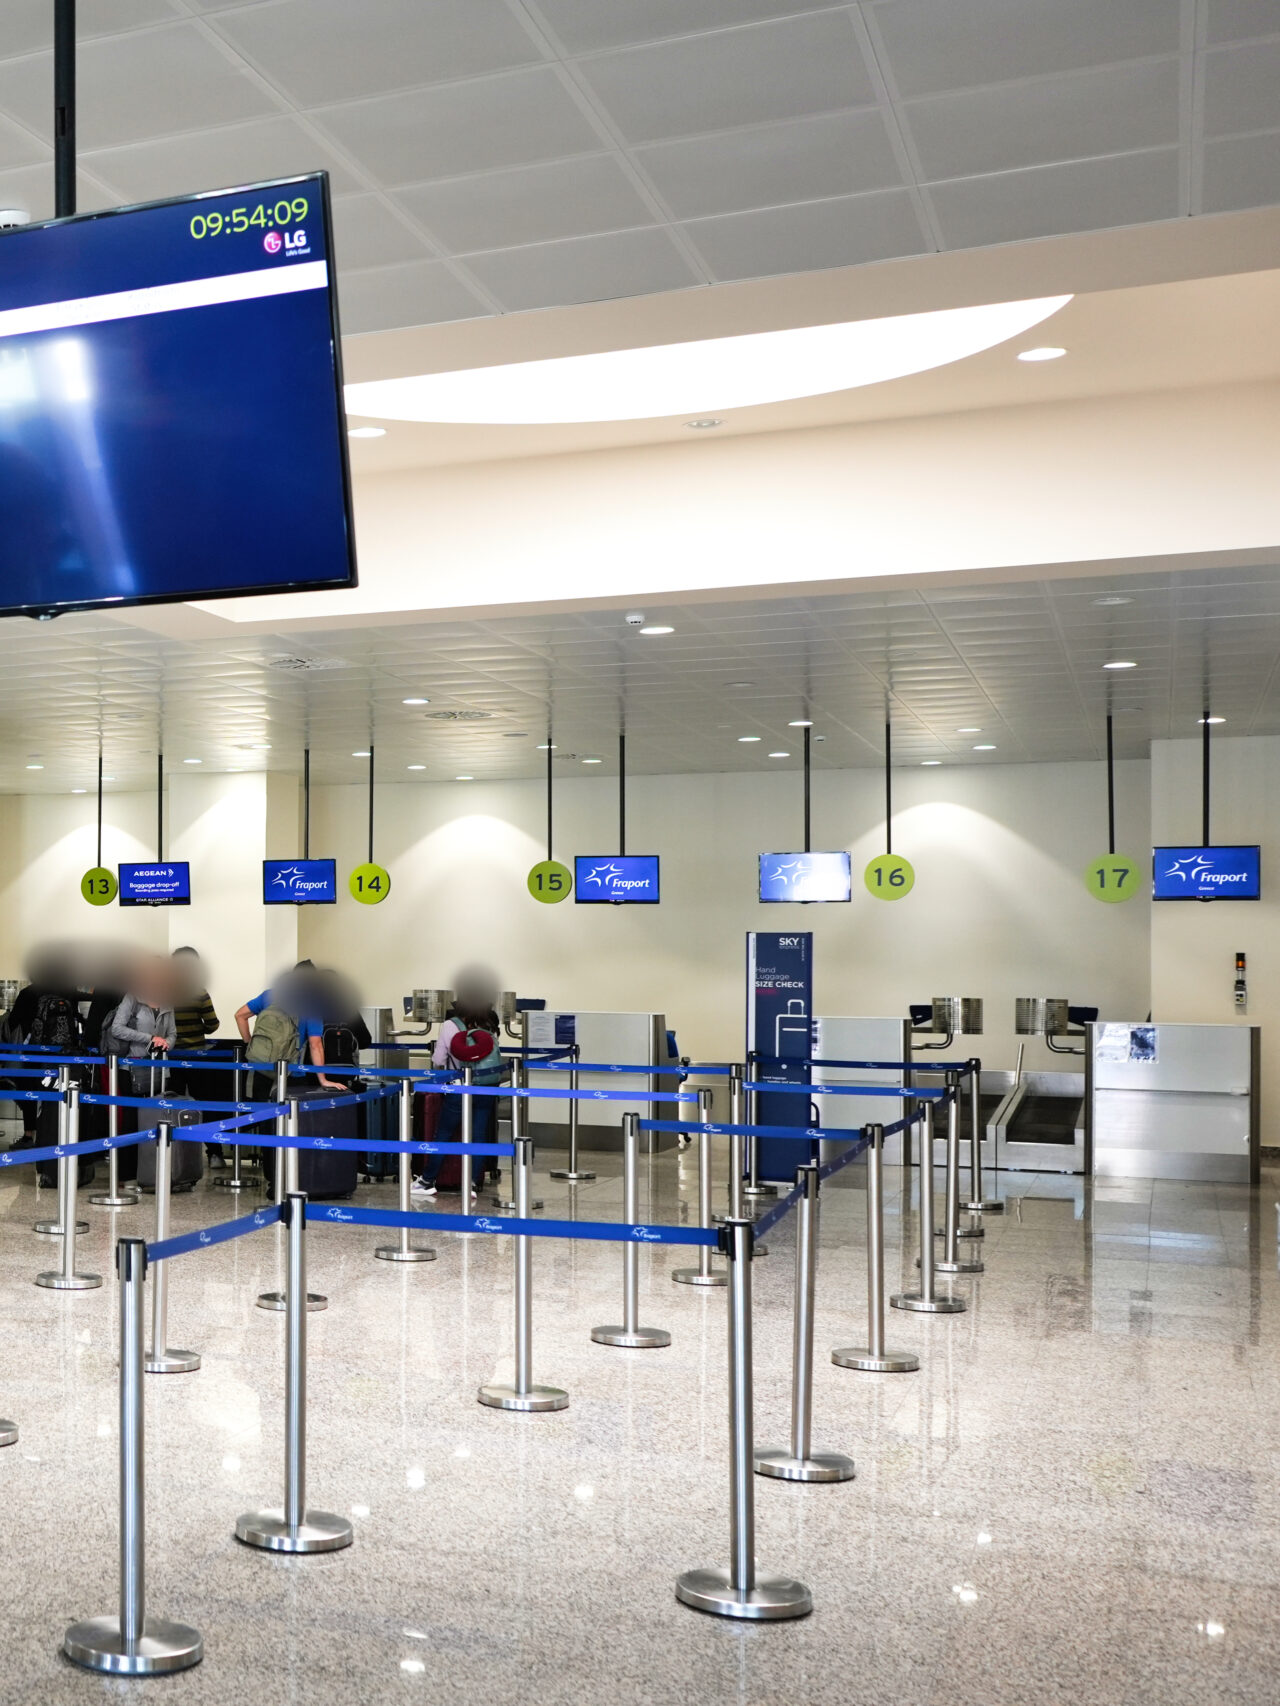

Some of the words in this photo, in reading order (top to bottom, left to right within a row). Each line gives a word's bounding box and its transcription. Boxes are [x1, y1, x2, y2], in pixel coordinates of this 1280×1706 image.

[190, 197, 309, 239] 09:54:09
[284, 229, 308, 249] LG
[356, 875, 381, 892] 14
[535, 873, 563, 891] 15
[612, 879, 650, 890] Fraport
[874, 867, 905, 887] 16
[1095, 868, 1130, 889] 17
[1200, 872, 1248, 884] Fraport
[88, 879, 110, 895] 13
[295, 880, 328, 891] Fraport
[779, 937, 800, 946] SKY
[755, 966, 776, 974] Hand
